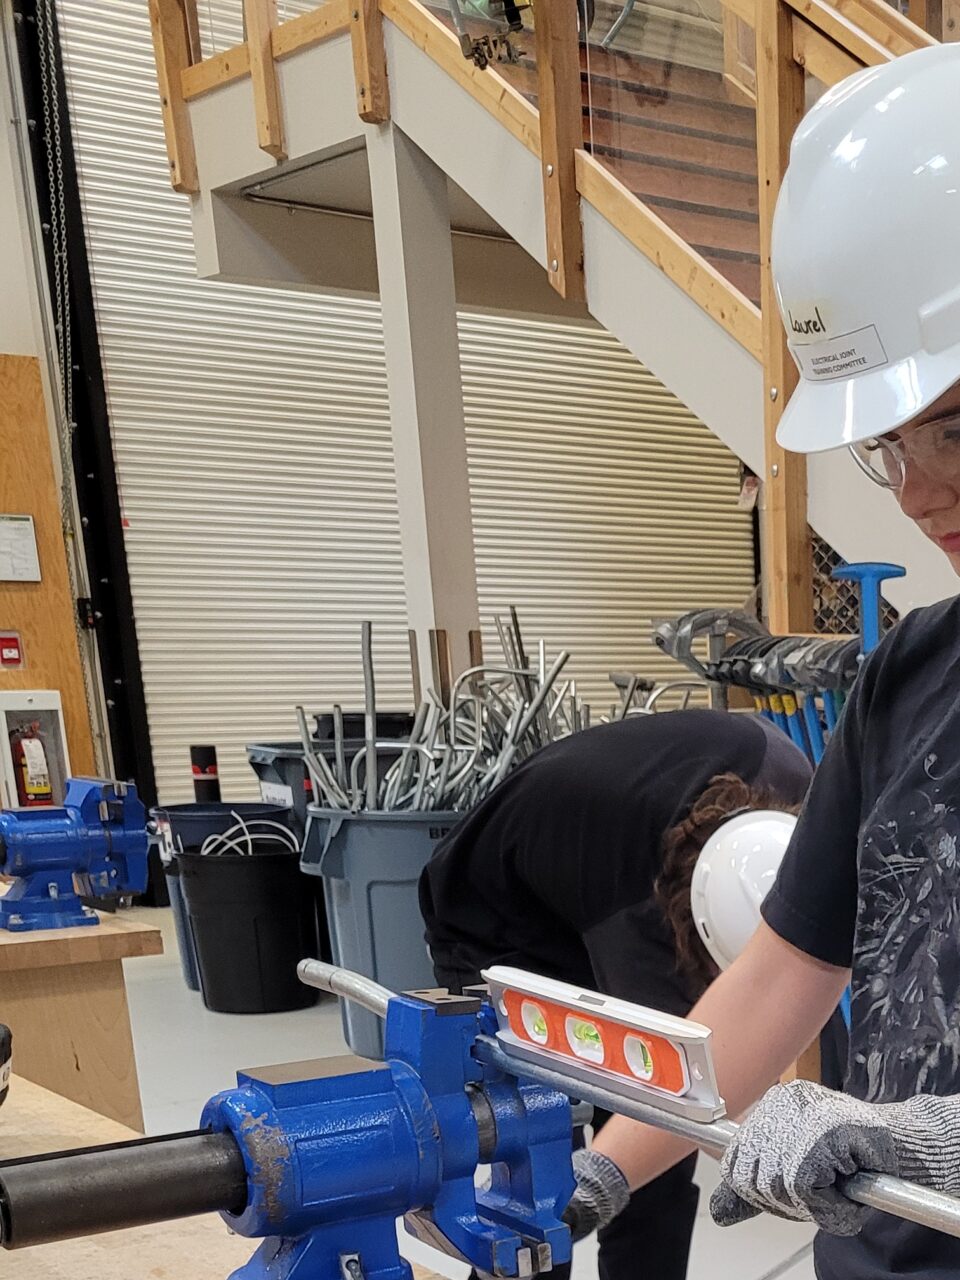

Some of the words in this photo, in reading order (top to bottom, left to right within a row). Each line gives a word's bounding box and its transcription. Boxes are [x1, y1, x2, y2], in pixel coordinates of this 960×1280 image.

[788, 306, 826, 334] Laurel
[839, 348, 857, 359] JOINT
[833, 356, 868, 372] COMMITTEE
